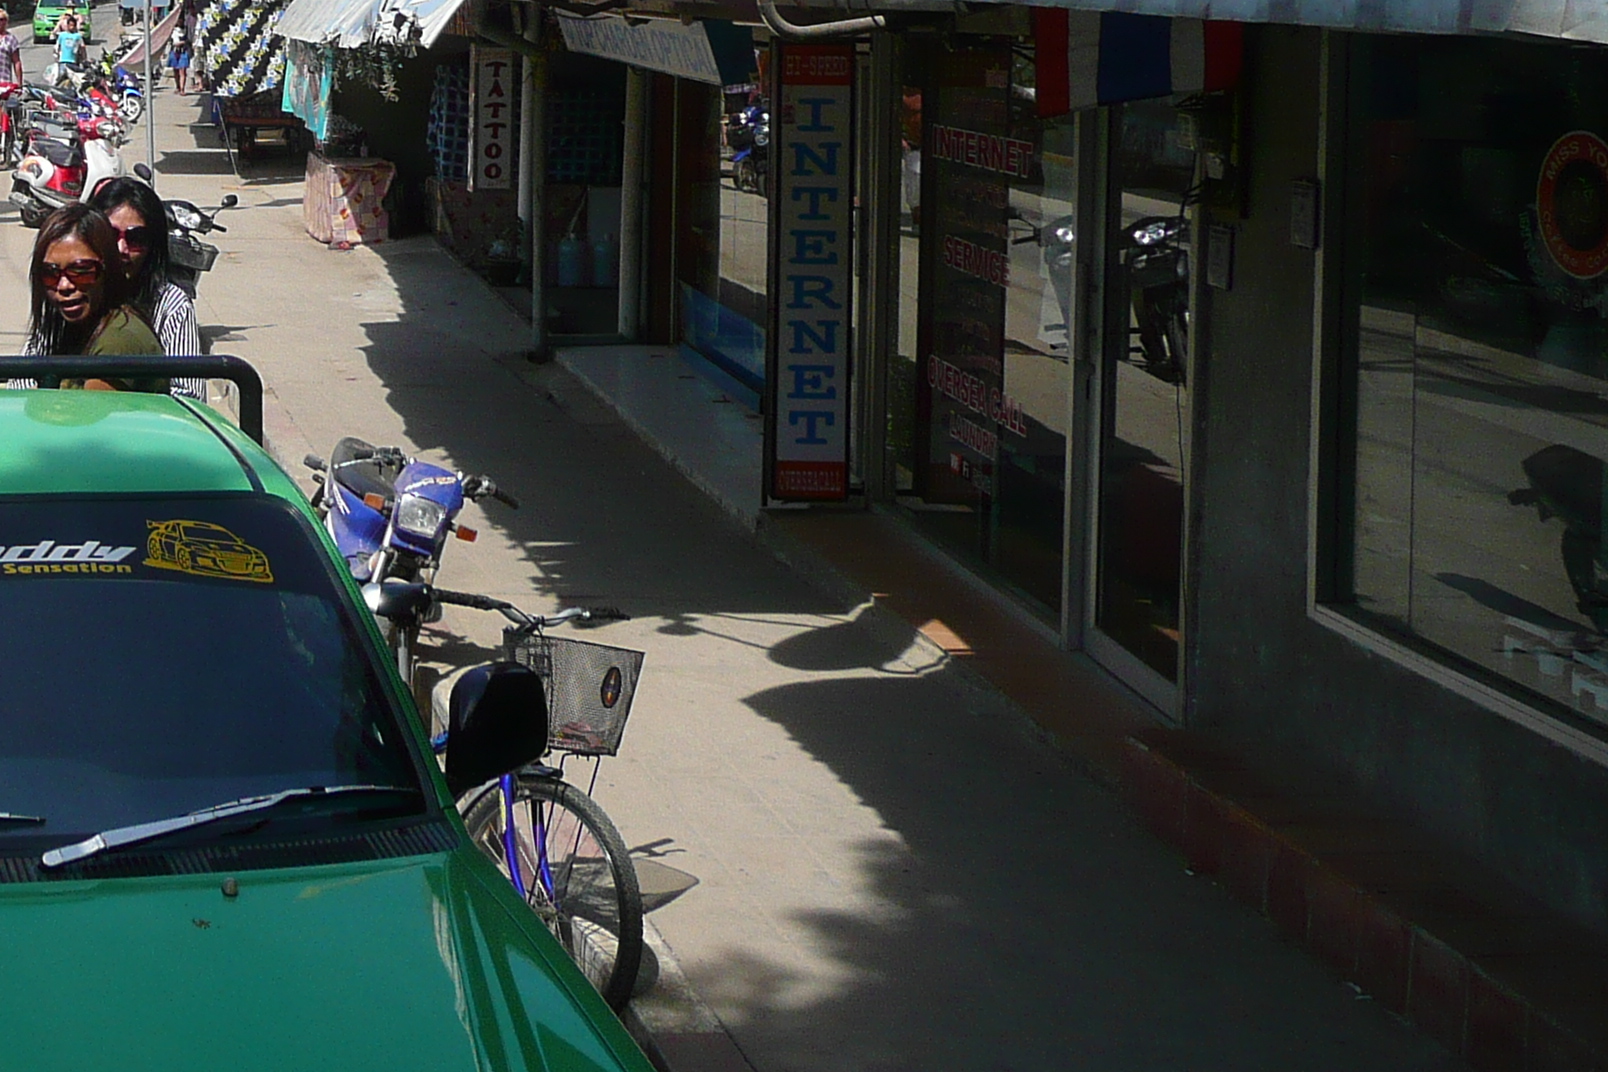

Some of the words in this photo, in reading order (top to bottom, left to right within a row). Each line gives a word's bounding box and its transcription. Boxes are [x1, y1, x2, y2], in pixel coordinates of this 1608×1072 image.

[785, 55, 848, 77] HI-SPEED
[483, 61, 507, 180] TATTOO
[932, 123, 1034, 178] INTERNET
[1546, 141, 1580, 180] MISS
[1588, 141, 1608, 172] YO
[785, 98, 842, 446] INTERNET
[943, 234, 1011, 287] SERVICE
[927, 354, 988, 417] OVERSEA
[989, 387, 1028, 437] CALL
[3, 562, 133, 576] Sensation
